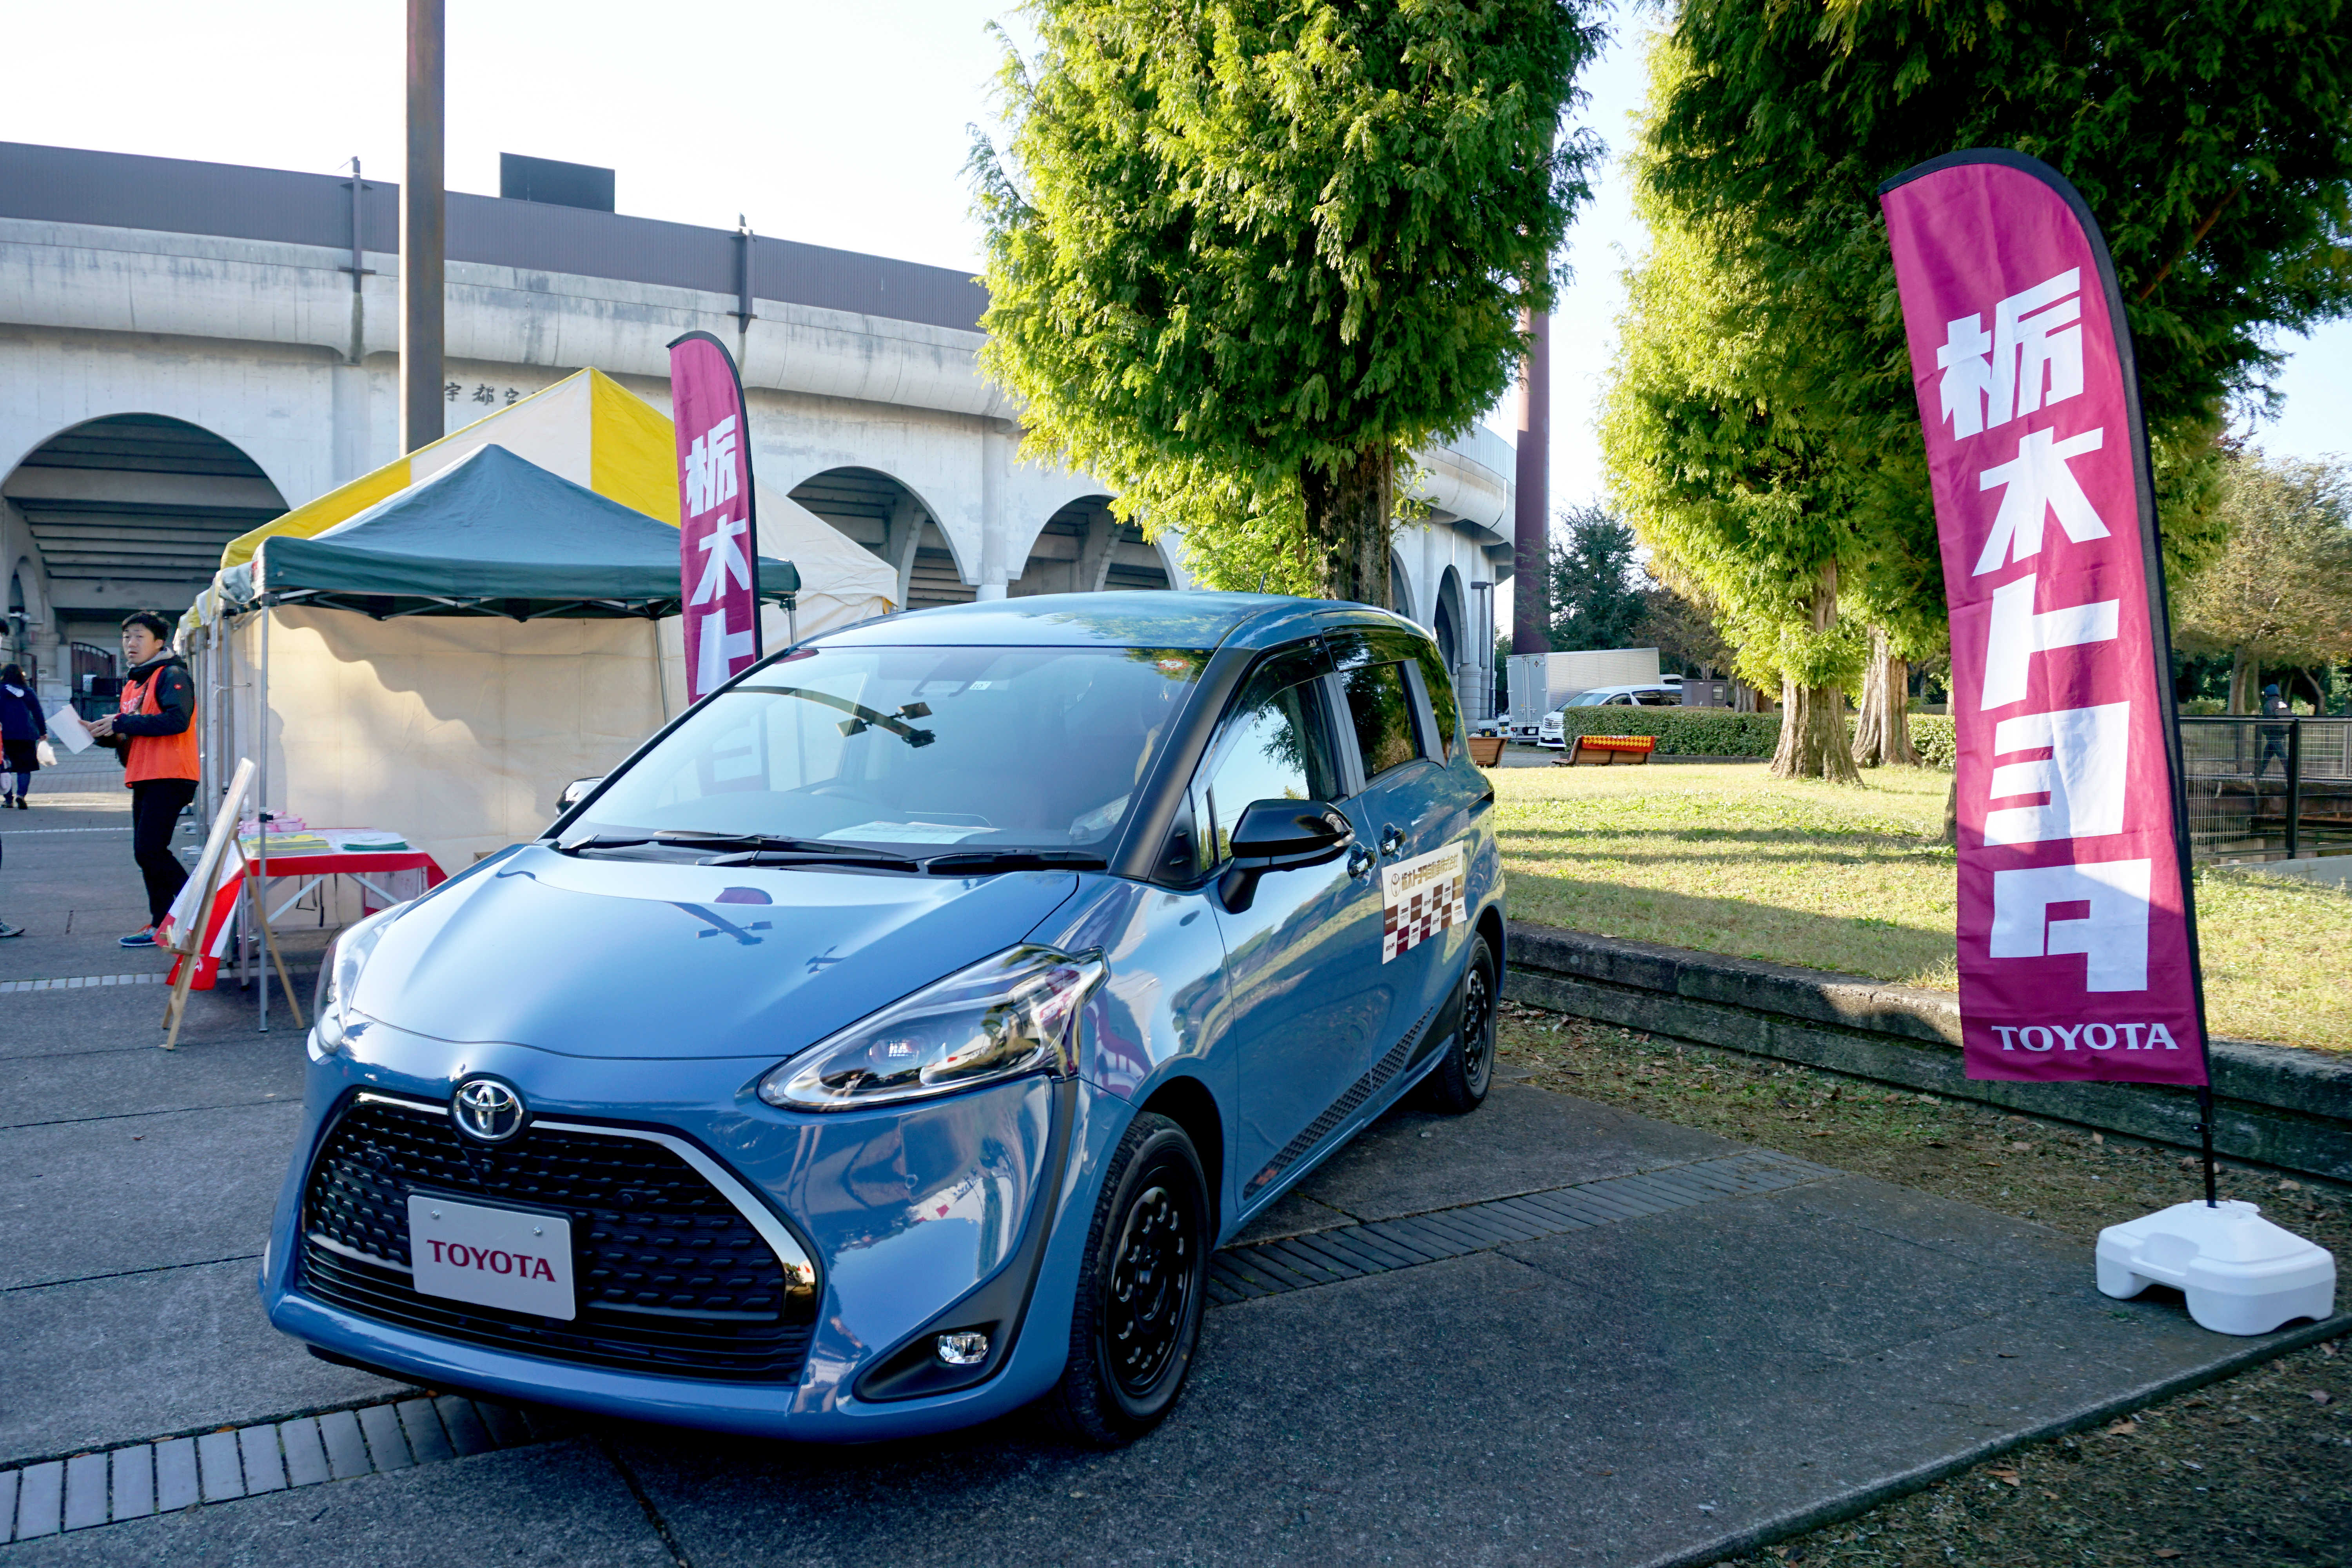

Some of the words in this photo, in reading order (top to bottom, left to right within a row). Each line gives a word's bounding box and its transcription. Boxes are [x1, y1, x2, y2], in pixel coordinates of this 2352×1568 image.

[1937, 267, 2152, 992] 栃木トヨタ
[1991, 1023, 2180, 1051] TOYOTA
[426, 1239, 557, 1282] TOYOTA
